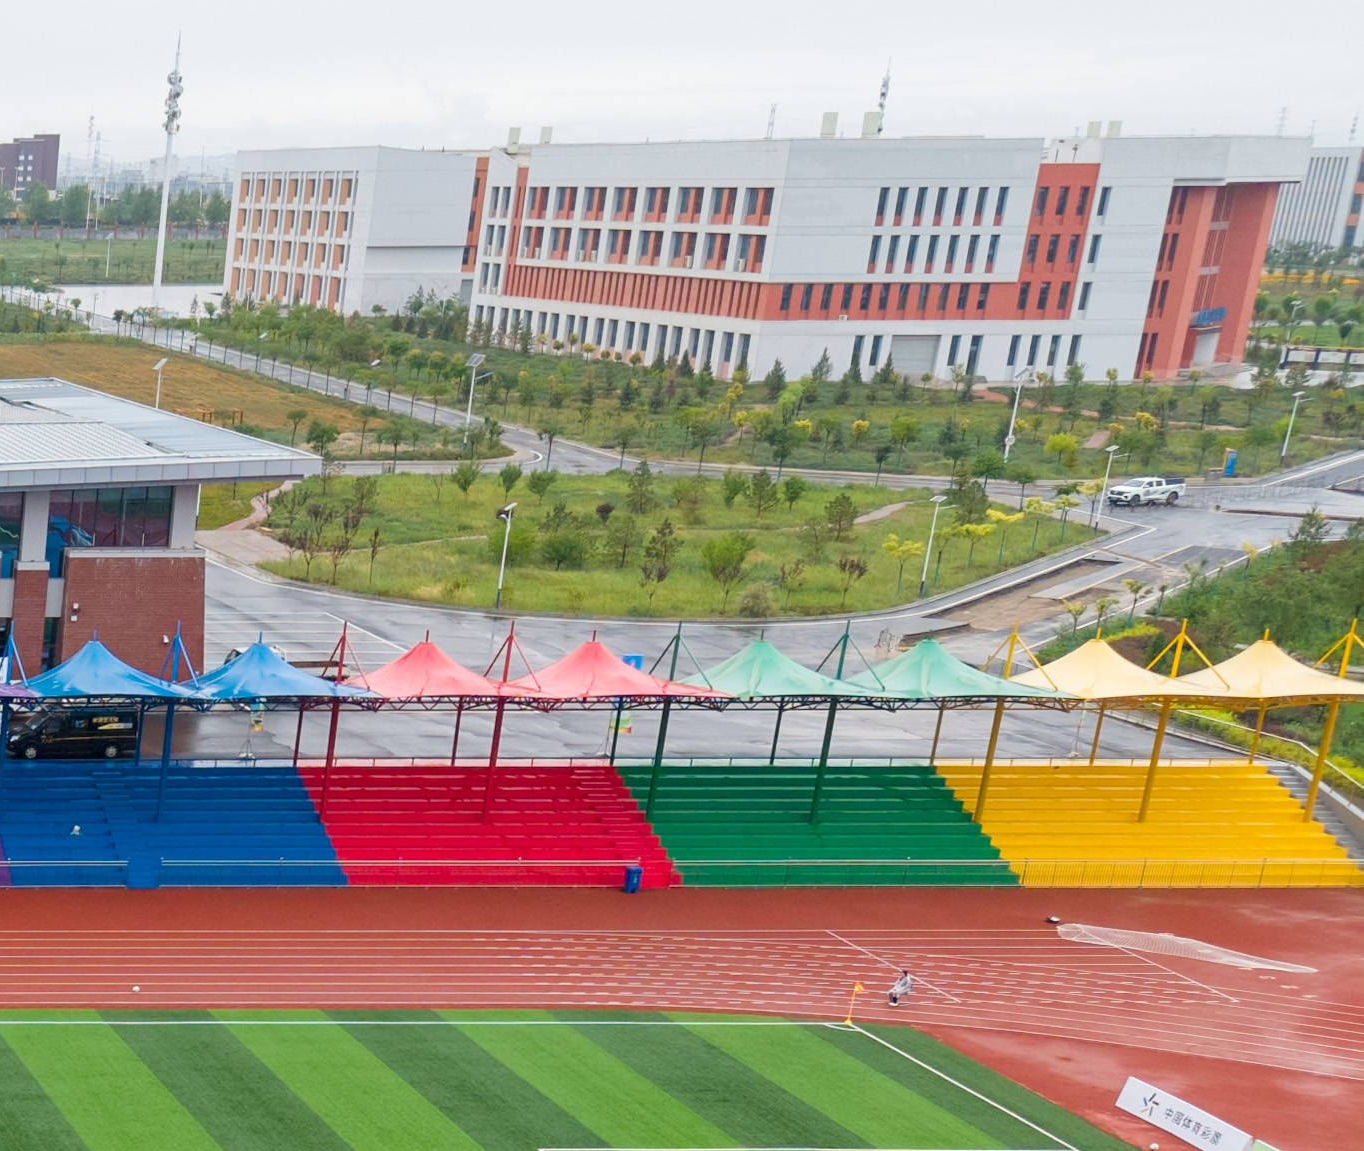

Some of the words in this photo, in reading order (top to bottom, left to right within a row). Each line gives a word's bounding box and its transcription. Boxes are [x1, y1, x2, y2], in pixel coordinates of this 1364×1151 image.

[1166, 1108, 1222, 1145] 中国体育彩票
